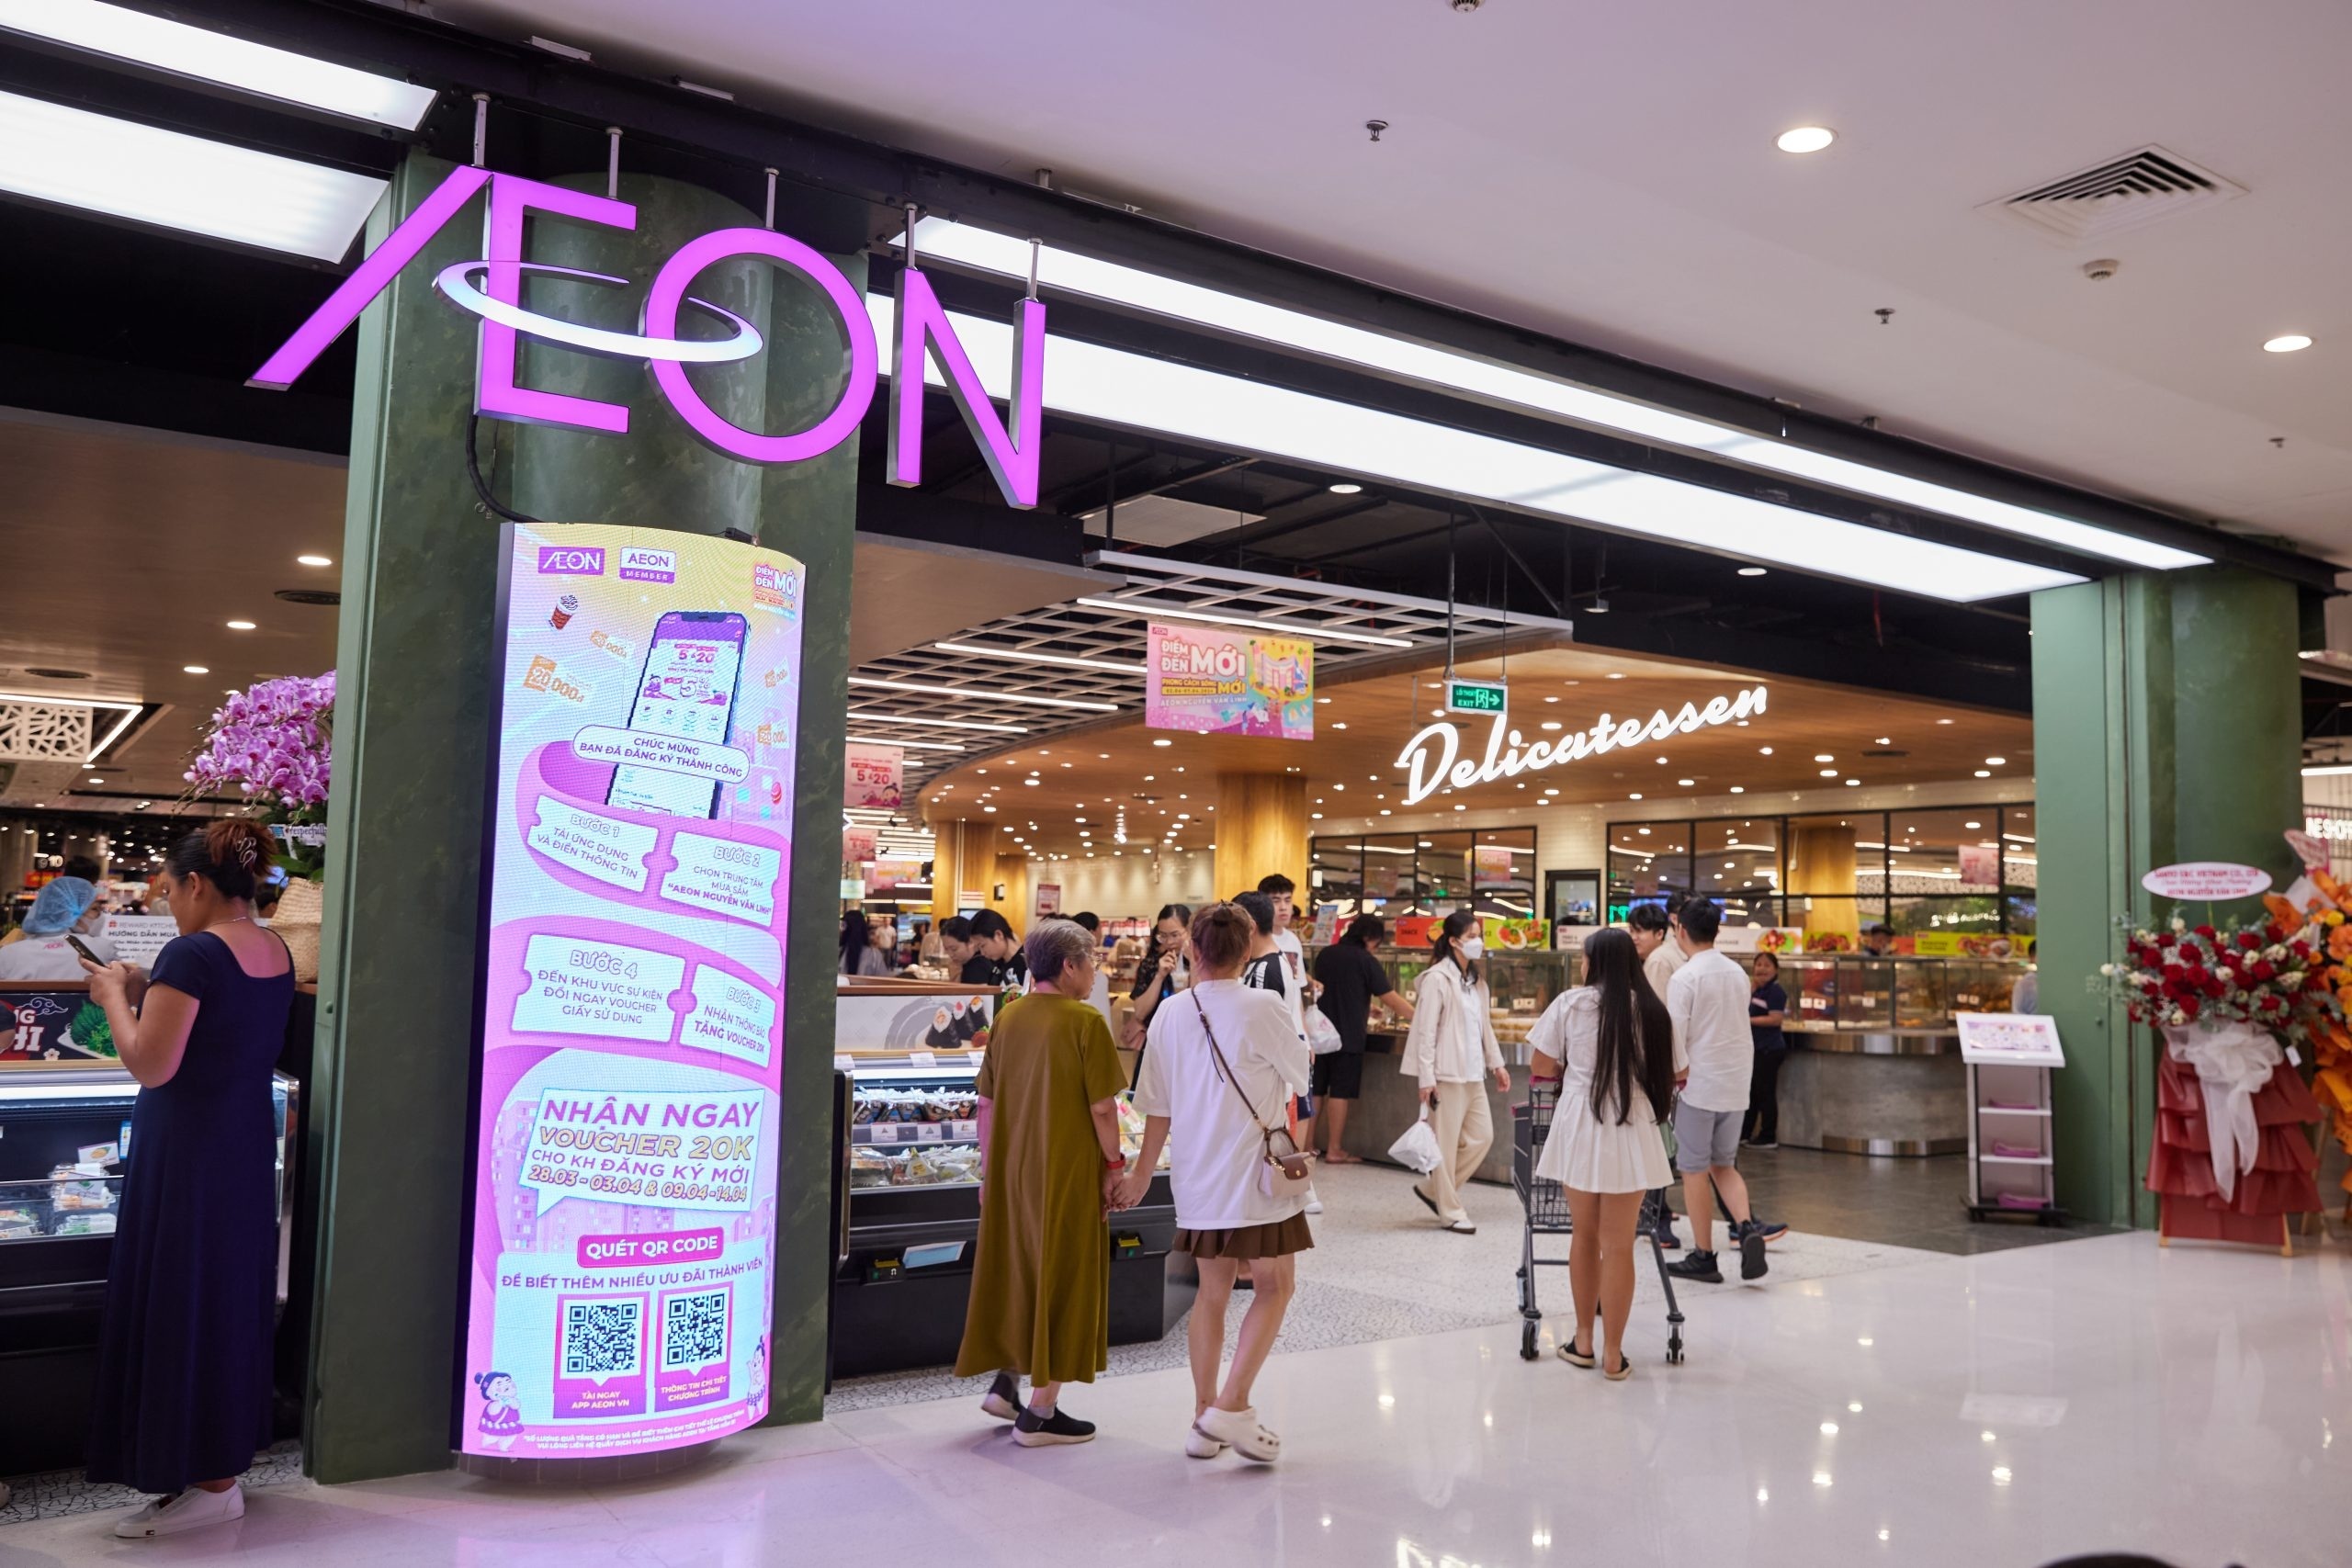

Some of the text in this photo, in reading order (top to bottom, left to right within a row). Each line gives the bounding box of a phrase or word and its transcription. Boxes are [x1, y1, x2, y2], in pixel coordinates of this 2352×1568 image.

[628, 552, 670, 568] AEON
[626, 570, 668, 581] MEMBER
[1161, 636, 1190, 655] ĐIỂM
[1161, 653, 1190, 673] ĐẾN
[1191, 643, 1247, 678] MỚI
[1217, 680, 1247, 695] MỚI
[1160, 698, 1181, 706] AEON
[1457, 699, 1475, 707] EXIT
[633, 738, 700, 756] CHÚC MỪNG
[1394, 685, 1768, 806] Delicatessen
[580, 742, 742, 778] BẠN ĐÃ ĐĂNG KÝ THÀNH CÔNG
[857, 770, 889, 784] 5 20
[571, 814, 620, 838] BƯỚC 1
[49, 854, 64, 868] 10
[537, 834, 550, 846] VÀ
[581, 851, 618, 872] THÔNG
[621, 865, 639, 879] TIN
[713, 845, 761, 867] BƯỚC 2
[711, 882, 730, 892] MUA
[723, 872, 749, 886] TRUNG
[570, 949, 639, 980] BƯỚC 4
[537, 969, 568, 984] ĐẾN
[571, 976, 598, 989] KHU
[572, 991, 606, 1006] NGAY
[609, 997, 657, 1013] VOUCHER
[726, 986, 762, 1014] BƯỚC 3
[704, 1004, 734, 1025] NHẬN
[735, 1016, 756, 1034] THÔNG
[695, 1020, 725, 1039] TẶNG
[727, 1030, 757, 1050] VOUCHER
[543, 1096, 760, 1131] NHẬN NGAY
[539, 1126, 754, 1161] VOUCHER 20K
[531, 1149, 750, 1184] CHO KH ĐĂNG KÝ MỚI
[527, 1164, 580, 1186] 28.03
[589, 1174, 642, 1195] 03.04
[644, 1179, 658, 1197] &
[586, 1235, 718, 1260] QUÉT QR CODE
[526, 1273, 558, 1288] BIẾT
[561, 1275, 605, 1289] THÊM
[609, 1271, 656, 1287] NHIỀU
[660, 1272, 679, 1284] ƯU
[683, 1268, 706, 1282] ĐÃI
[708, 1263, 745, 1280] THÀNH
[746, 1257, 763, 1271] VIÊN
[596, 1391, 621, 1399] NGAY
[661, 1382, 688, 1394] THÔNG
[688, 1381, 701, 1390] TIN
[701, 1379, 713, 1388] CHI
[571, 1399, 630, 1409] APP AEON VN
